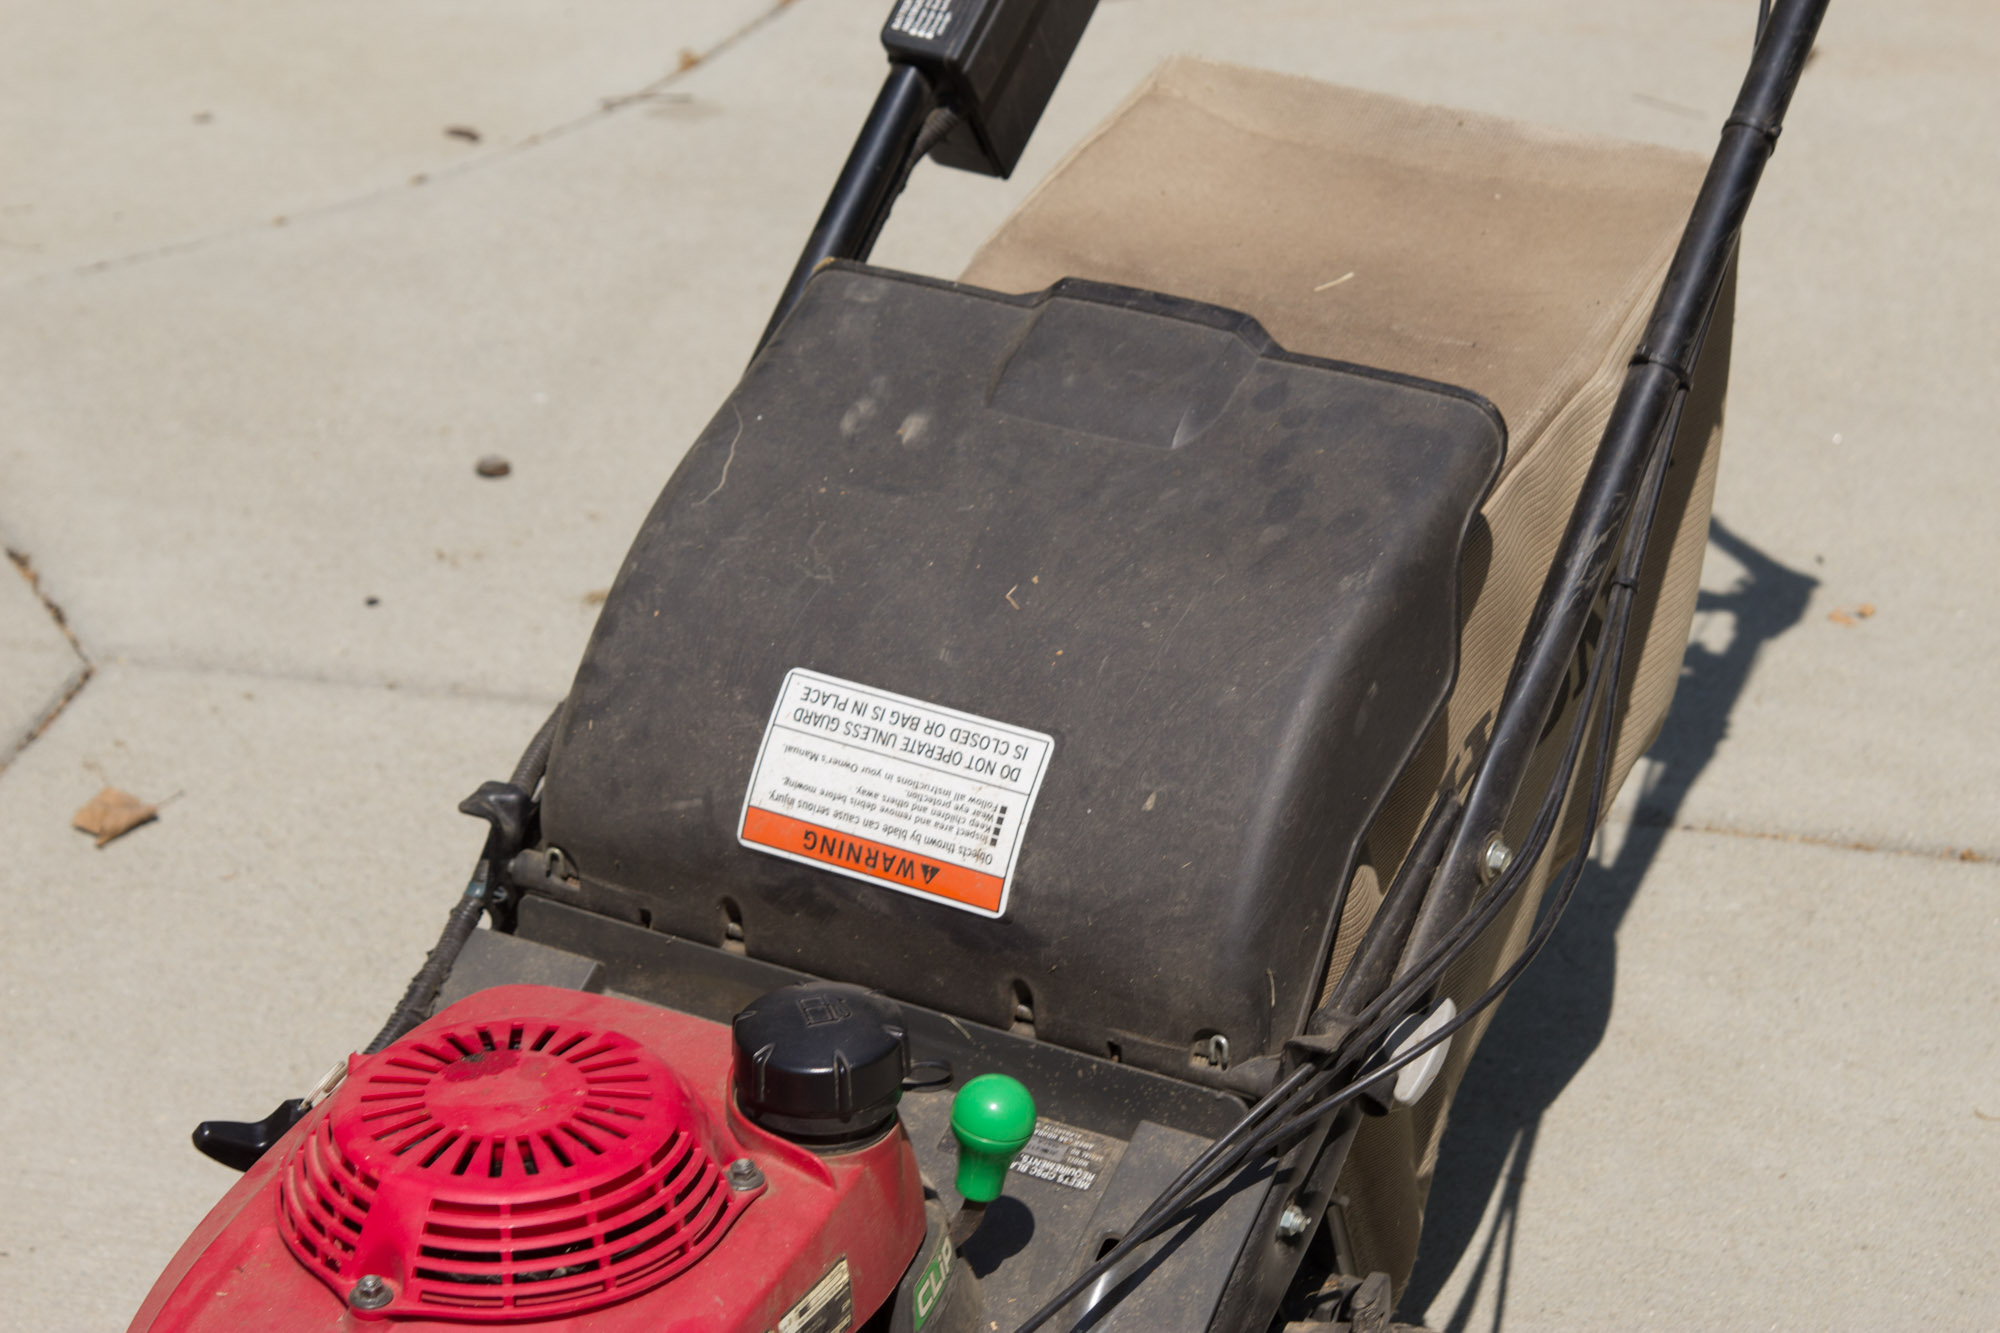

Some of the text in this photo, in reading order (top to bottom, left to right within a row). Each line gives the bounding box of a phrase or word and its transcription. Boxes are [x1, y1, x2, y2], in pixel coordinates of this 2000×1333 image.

[800, 686, 1029, 761] IS CLOSED OR BAG IS IN PLACE
[793, 707, 1022, 783] DO NOT OPERATE UNLESS GUARD
[821, 754, 859, 773] Owner's
[860, 766, 882, 777] your
[884, 772, 894, 782] in
[896, 775, 952, 798] instructions
[819, 789, 848, 804] before
[882, 794, 910, 809] others
[953, 792, 966, 802] all
[797, 799, 830, 816] serious
[850, 797, 877, 812] debris
[910, 803, 929, 813] and
[953, 803, 970, 814] eye
[967, 796, 999, 813] Follow
[832, 810, 860, 825] cause
[879, 807, 913, 821] remove
[913, 815, 932, 826] and
[930, 809, 967, 825] children
[972, 809, 994, 822] Wear
[862, 818, 880, 831] can
[933, 821, 954, 832] area
[968, 818, 992, 834] Keep
[882, 825, 908, 841] blade
[909, 829, 922, 845] by
[955, 827, 989, 845] Inspect
[923, 836, 956, 854] thrown
[803, 830, 914, 880] WARNING
[958, 845, 993, 866] Objects
[1009, 1161, 1029, 1173] BLA
[1057, 1174, 1092, 1190] MEETS
